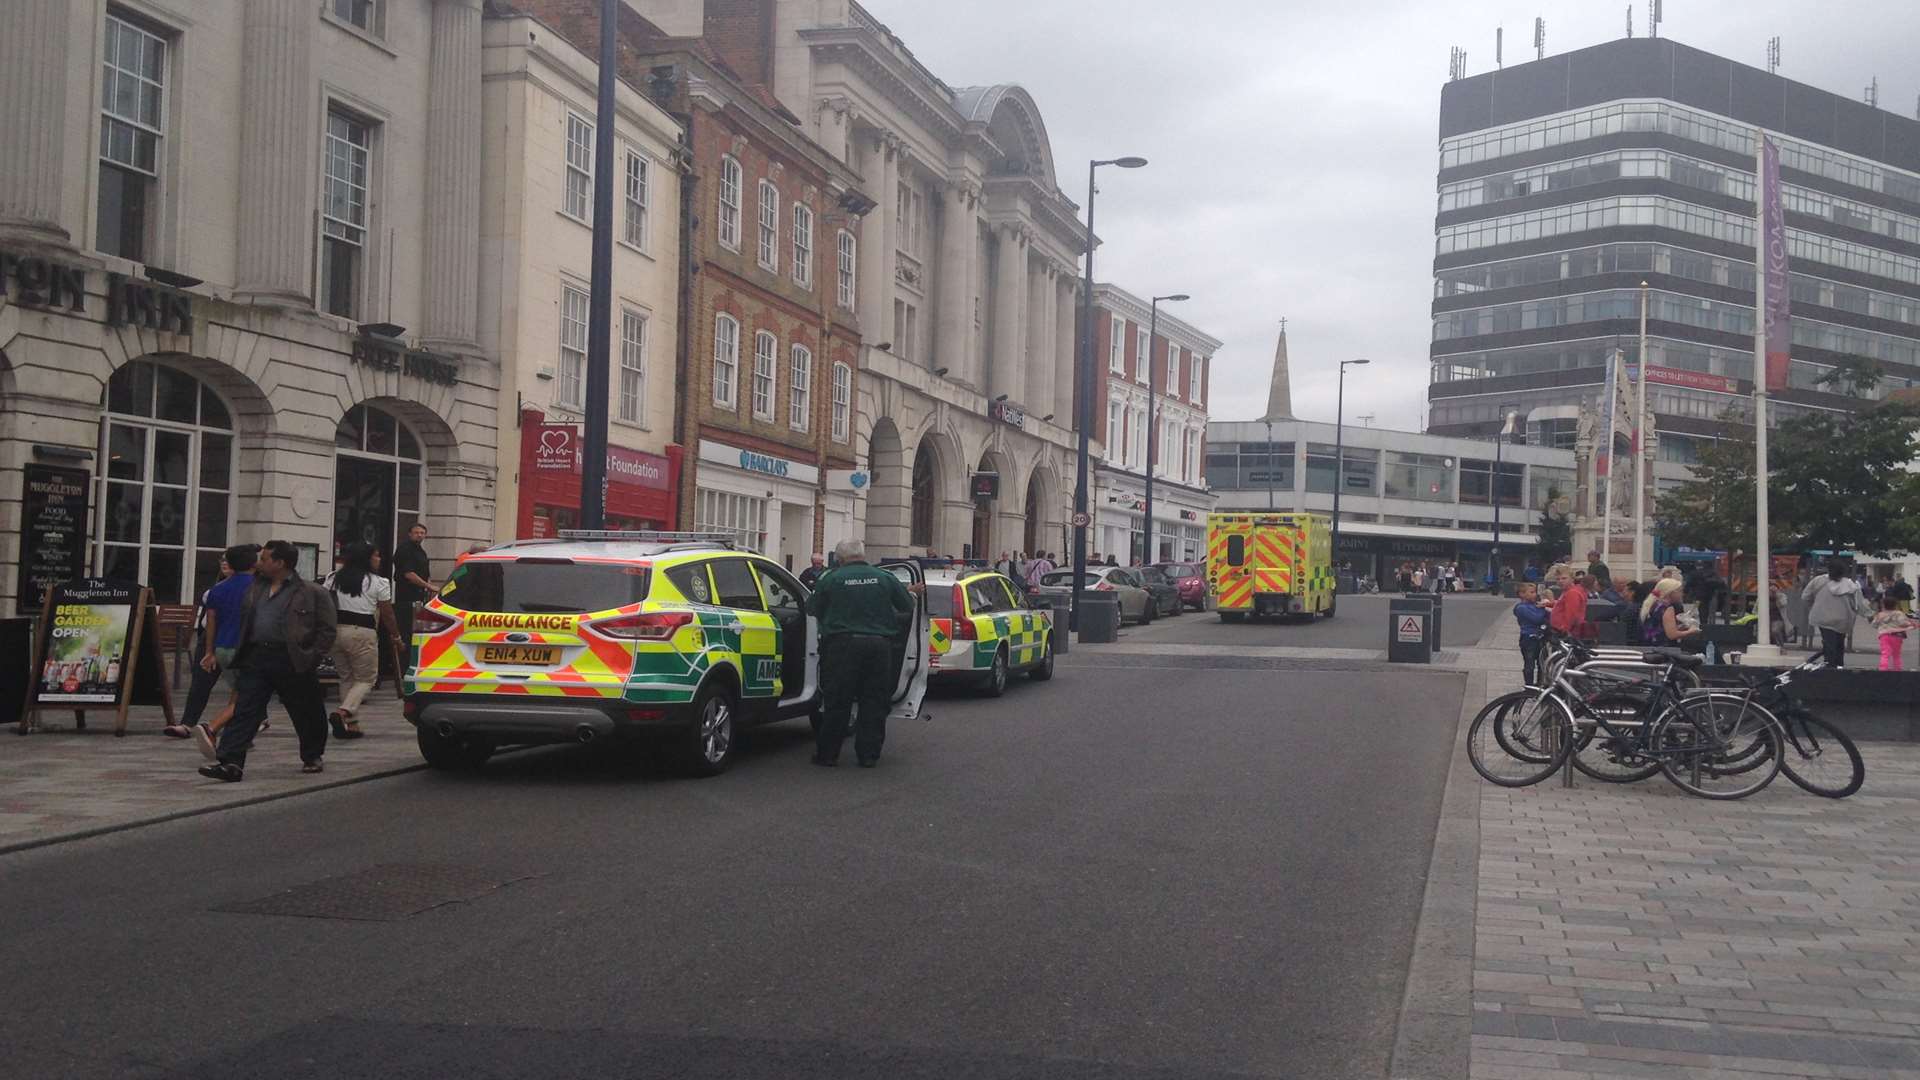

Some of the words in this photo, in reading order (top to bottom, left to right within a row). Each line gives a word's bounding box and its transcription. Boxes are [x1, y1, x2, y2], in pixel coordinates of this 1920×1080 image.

[107, 271, 192, 336] INN
[611, 456, 659, 479] Foundation
[751, 454, 789, 476] BARCLAYS
[30, 481, 82, 496] MUGGLETON
[88, 580, 105, 588] The
[844, 578, 878, 586] AMBULANCE
[63, 589, 111, 599] Muggleton
[113, 589, 128, 597] Inn
[56, 604, 89, 615] BEER
[54, 615, 112, 626] GARDEN
[468, 615, 573, 630] AMBULANCE
[52, 628, 89, 638] OPEN
[483, 647, 517, 662] EN14
[521, 648, 552, 662] XUW
